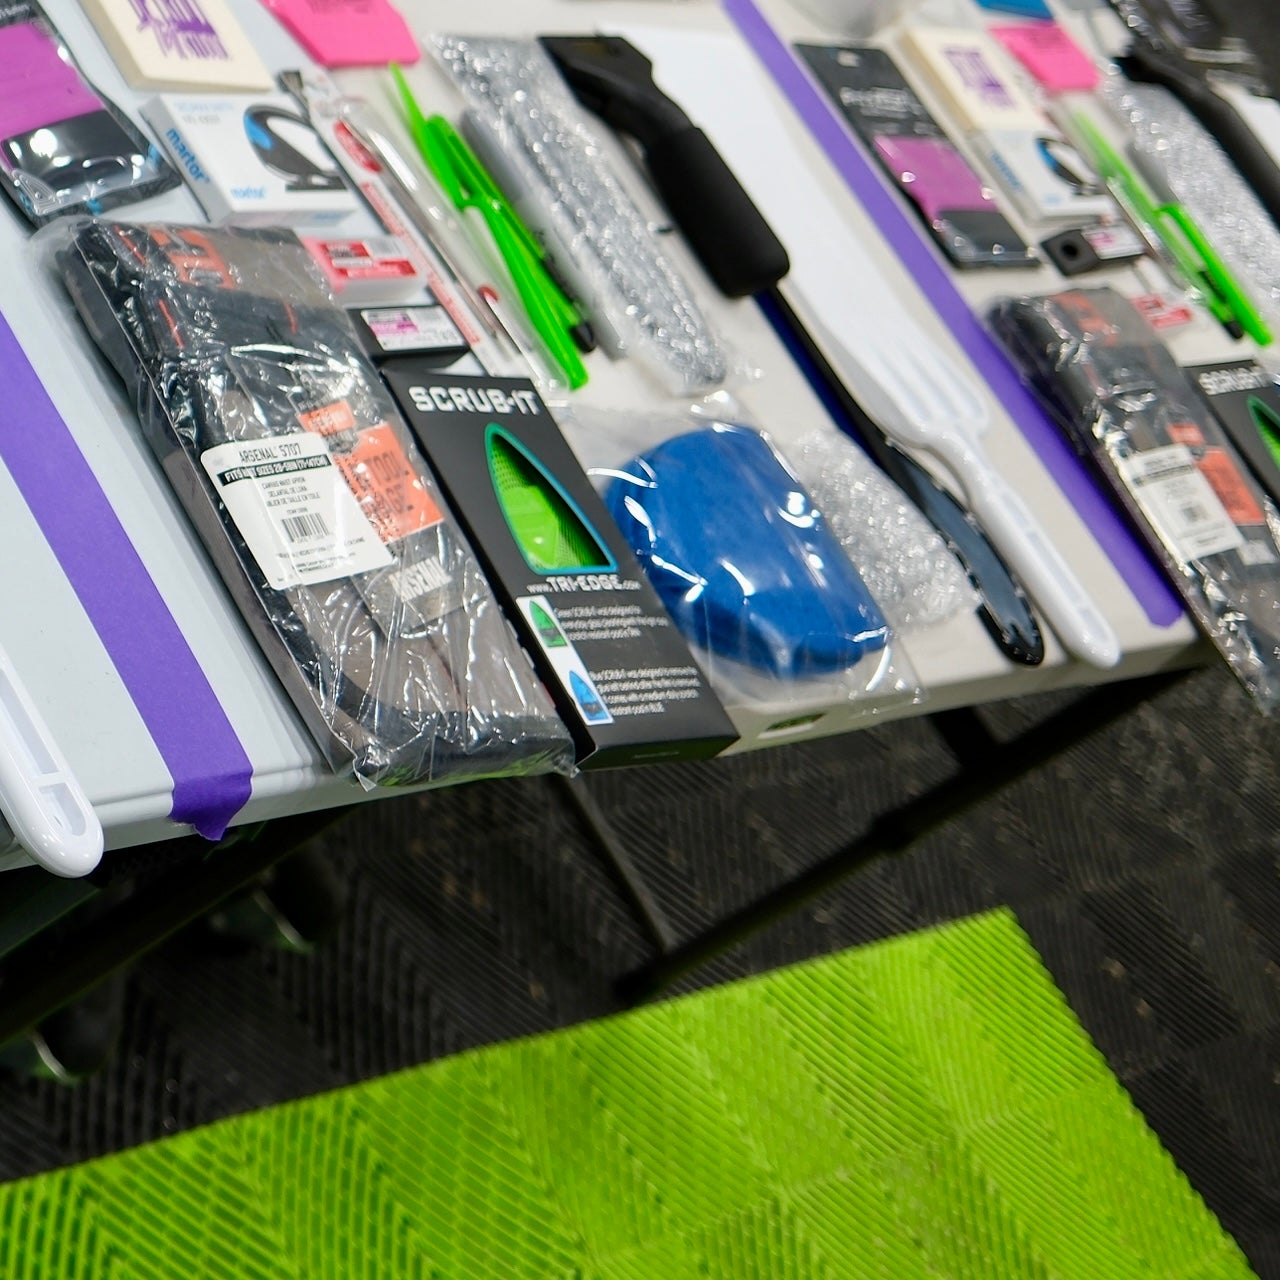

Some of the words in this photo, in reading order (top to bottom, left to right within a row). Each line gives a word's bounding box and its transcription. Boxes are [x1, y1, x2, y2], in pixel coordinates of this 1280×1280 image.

[166, 128, 207, 182] martor
[408, 385, 541, 416] SCRUB-IT
[239, 448, 276, 464] ARSENAL
[278, 443, 303, 458] 5707
[526, 574, 641, 594] www.TRI-EDGE.com
